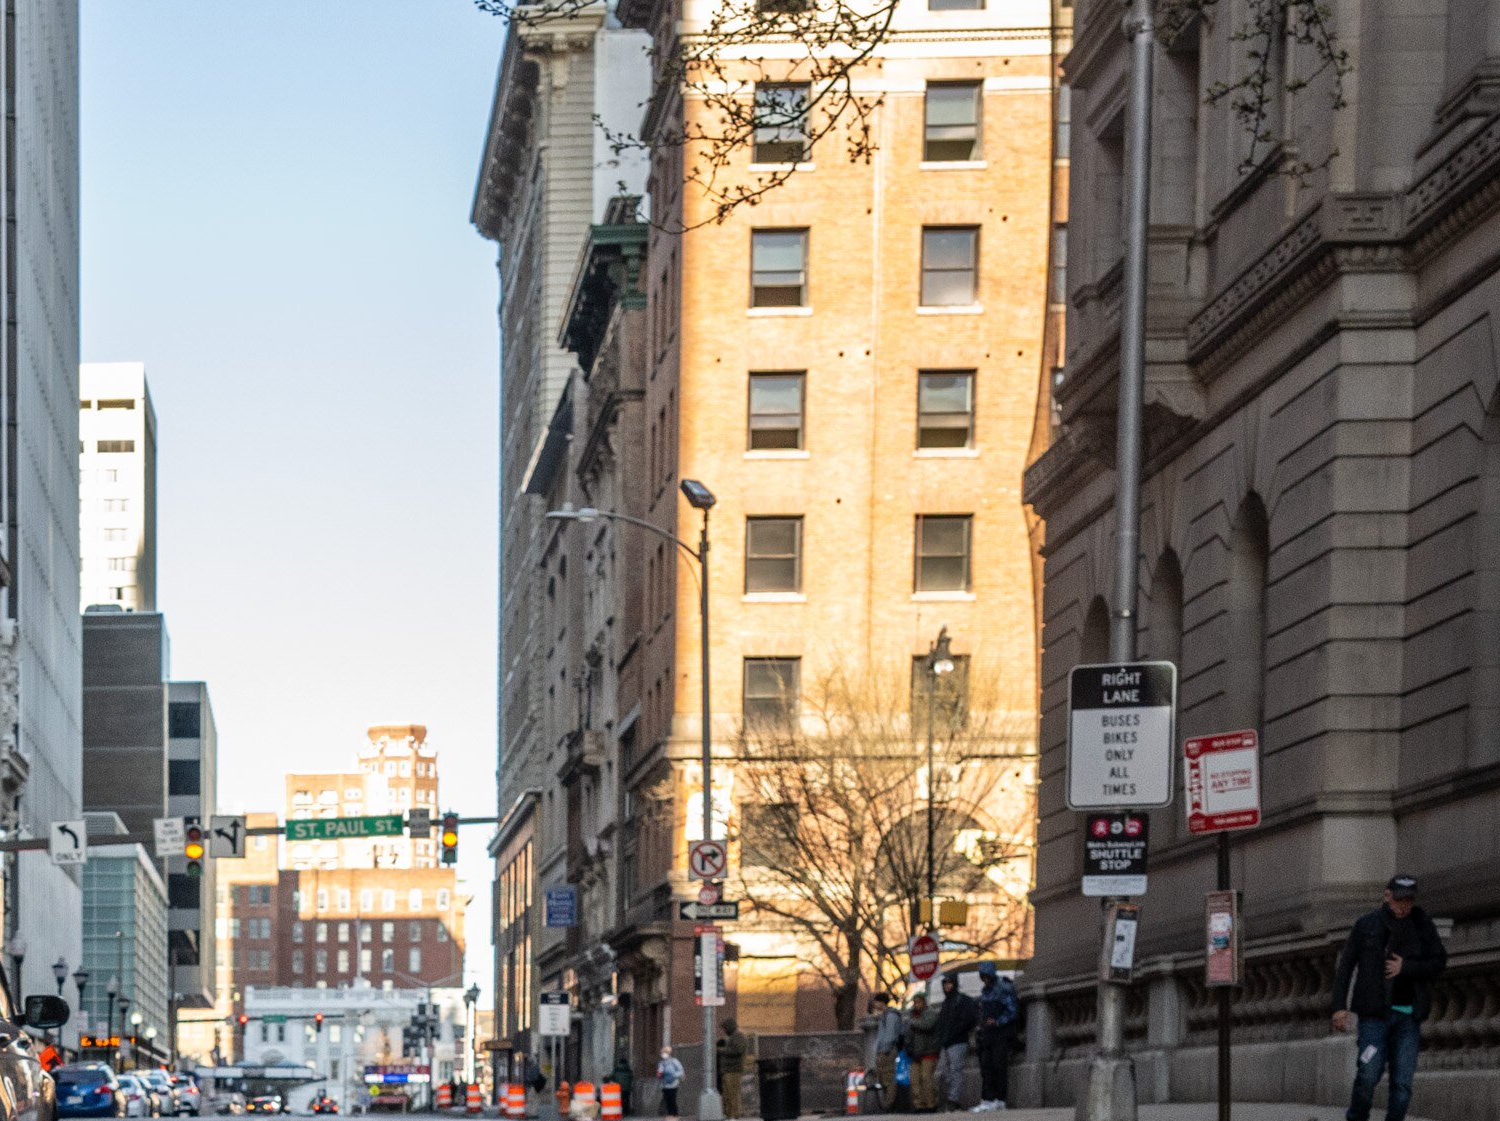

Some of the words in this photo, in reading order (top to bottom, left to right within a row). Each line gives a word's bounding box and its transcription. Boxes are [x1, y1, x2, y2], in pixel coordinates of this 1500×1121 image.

[1101, 672, 1141, 687] RIGHT
[1102, 689, 1140, 704] LANE
[1102, 713, 1141, 727] BUSES
[1103, 731, 1138, 744] BIKES
[1105, 749, 1134, 761] ONLY
[1109, 766, 1129, 779] ALL
[1102, 783, 1137, 796] TIMES
[294, 822, 321, 838] ST.
[325, 820, 369, 836] PAUL
[374, 819, 397, 833] ST.
[56, 851, 82, 860] ONLY
[1090, 848, 1142, 860] SHUTTLE
[1100, 860, 1132, 871] STOP
